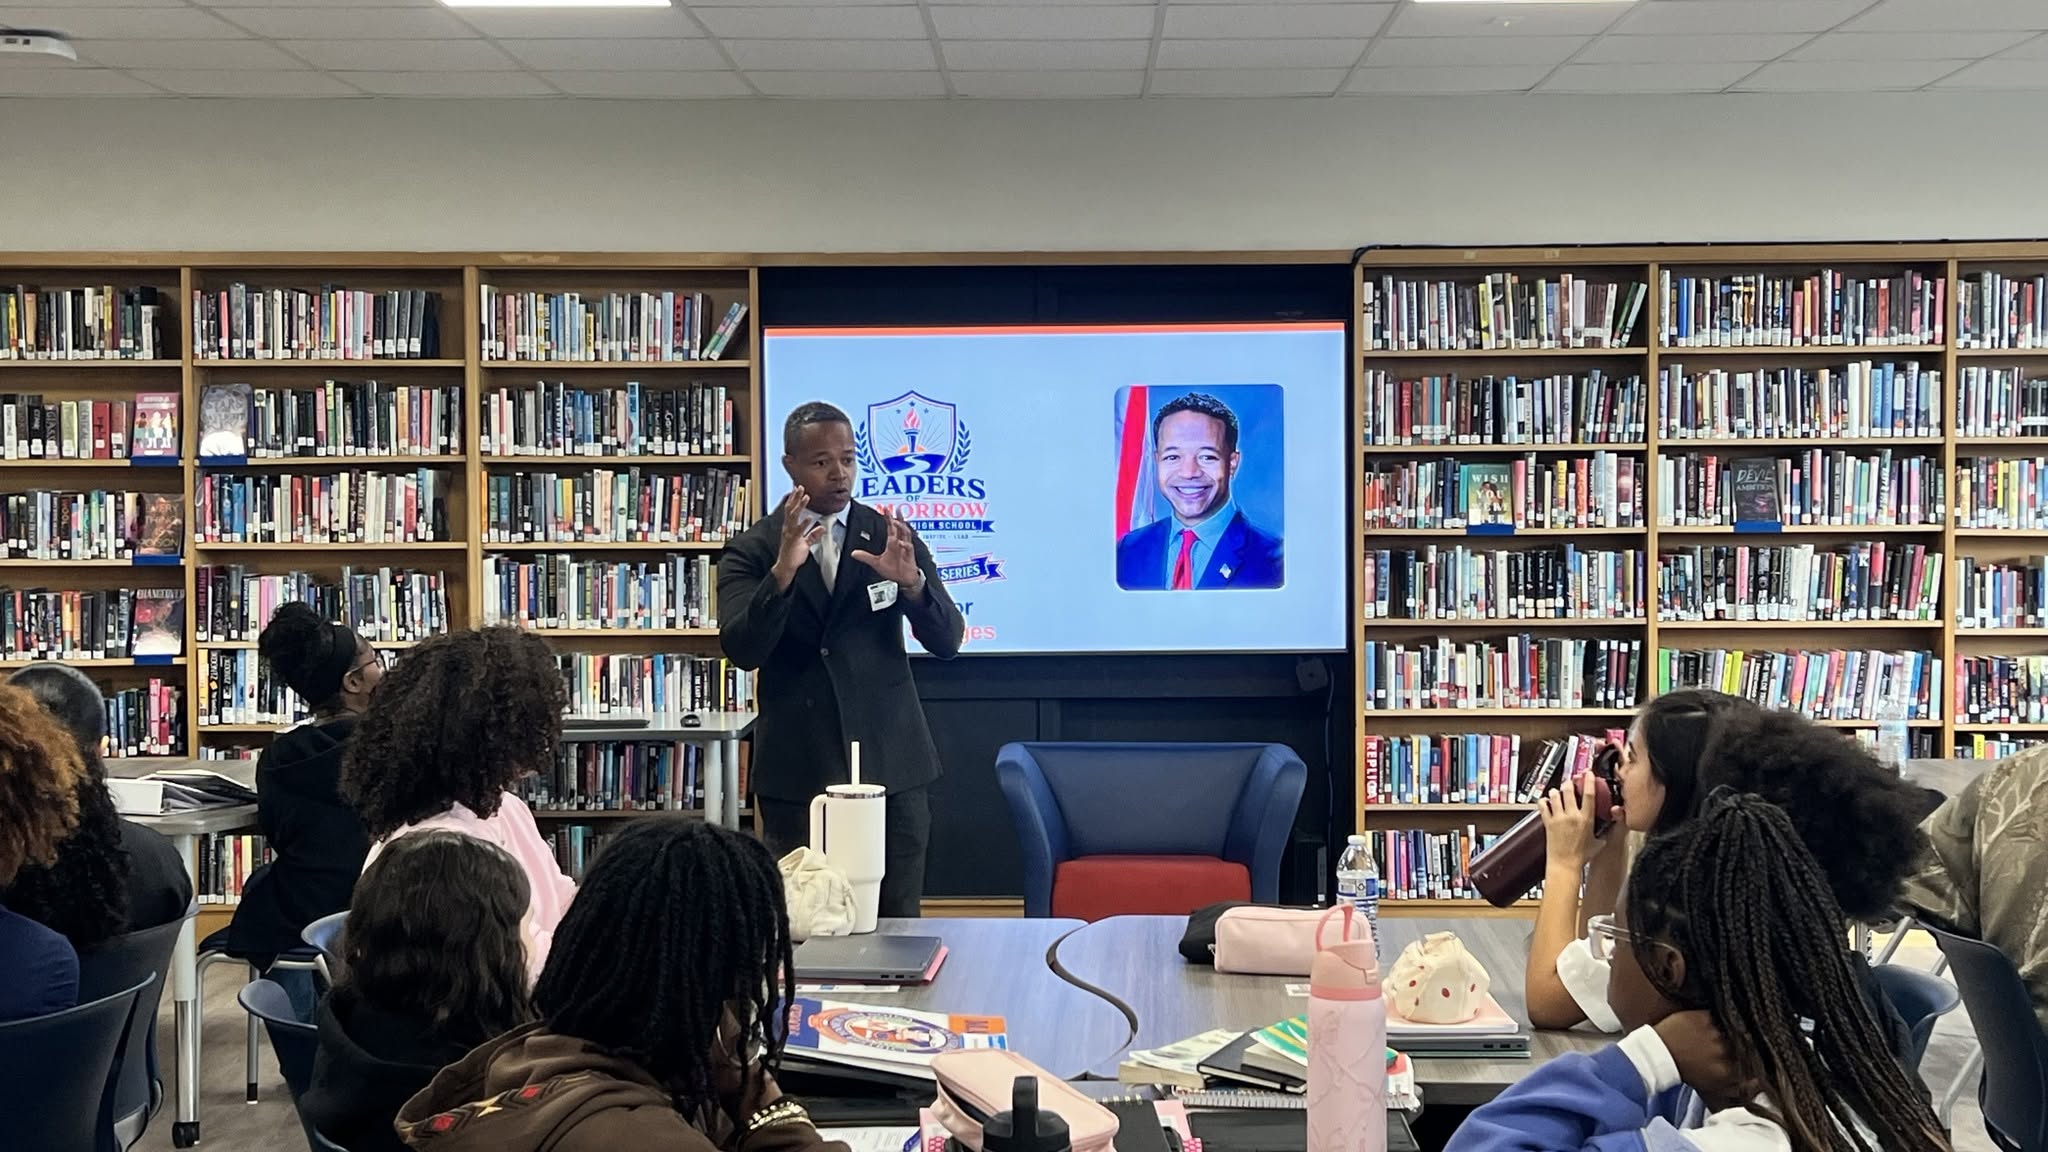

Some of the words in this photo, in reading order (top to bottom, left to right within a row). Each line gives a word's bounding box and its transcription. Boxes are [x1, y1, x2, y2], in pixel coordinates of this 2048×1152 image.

[1471, 474, 1508, 483] WISH
[855, 475, 986, 500] EADERS
[874, 502, 989, 519] MORROW
[938, 522, 977, 530] SCHOOL
[940, 563, 981, 581] SERIES
